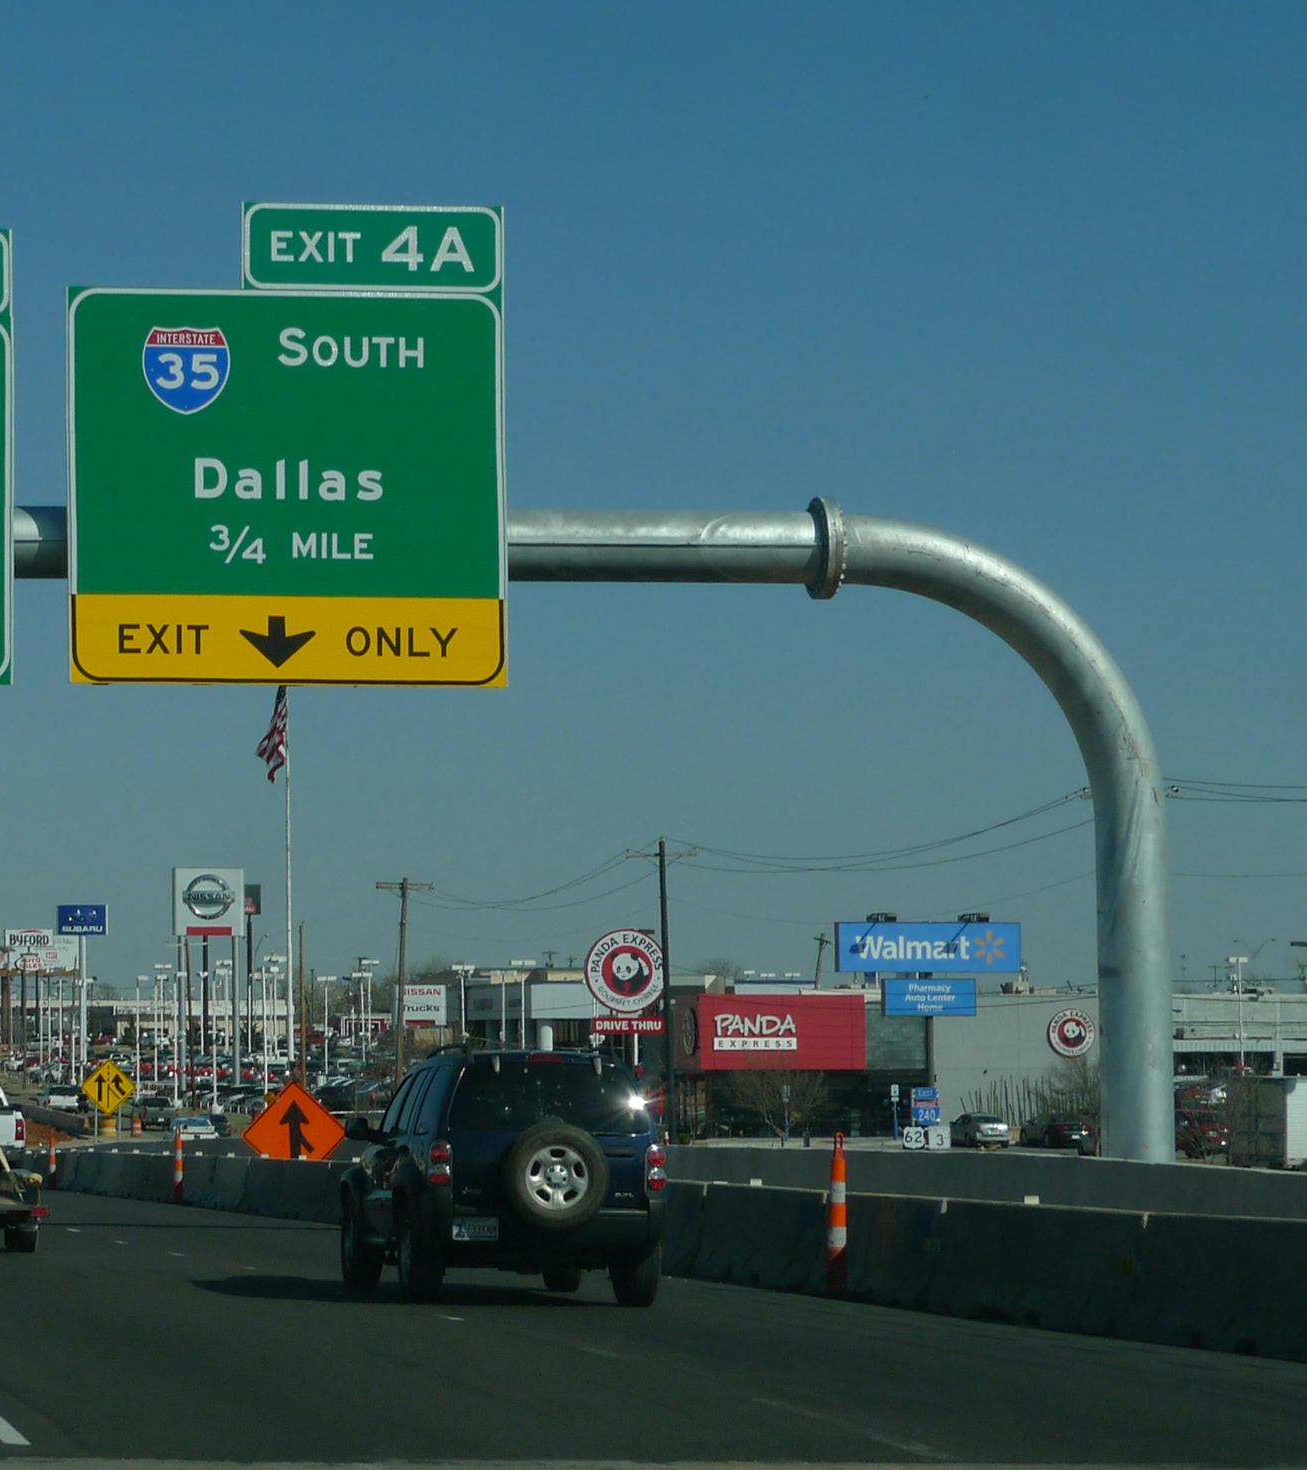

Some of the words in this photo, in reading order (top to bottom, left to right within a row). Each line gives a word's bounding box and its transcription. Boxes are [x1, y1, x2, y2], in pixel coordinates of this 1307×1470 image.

[271, 231, 361, 263] EXIT
[381, 226, 475, 273] 4A
[156, 333, 216, 345] INTERSTATE
[278, 327, 424, 368] SOUTH
[156, 353, 220, 390] 35
[194, 457, 384, 501] Dallas
[292, 532, 374, 560] MILE
[118, 624, 209, 655] EXIT
[345, 627, 458, 658] ONLY
[187, 892, 231, 901] NISSAN
[9, 934, 50, 946] BYFORD
[591, 937, 619, 973] PANDA
[623, 933, 663, 970] EXPRESS
[403, 988, 442, 996] ISSAN
[908, 983, 951, 994] Pharmacy
[904, 994, 925, 1002] Auto
[927, 994, 956, 1002] Center
[596, 1021, 629, 1031] DRIVE
[631, 1021, 662, 1031] THRU
[714, 1014, 796, 1036] PANDA
[718, 1039, 793, 1048] EXPRESS
[918, 1109, 936, 1121] 240
[904, 1130, 922, 1143] 62
[936, 1134, 944, 1146] 3
